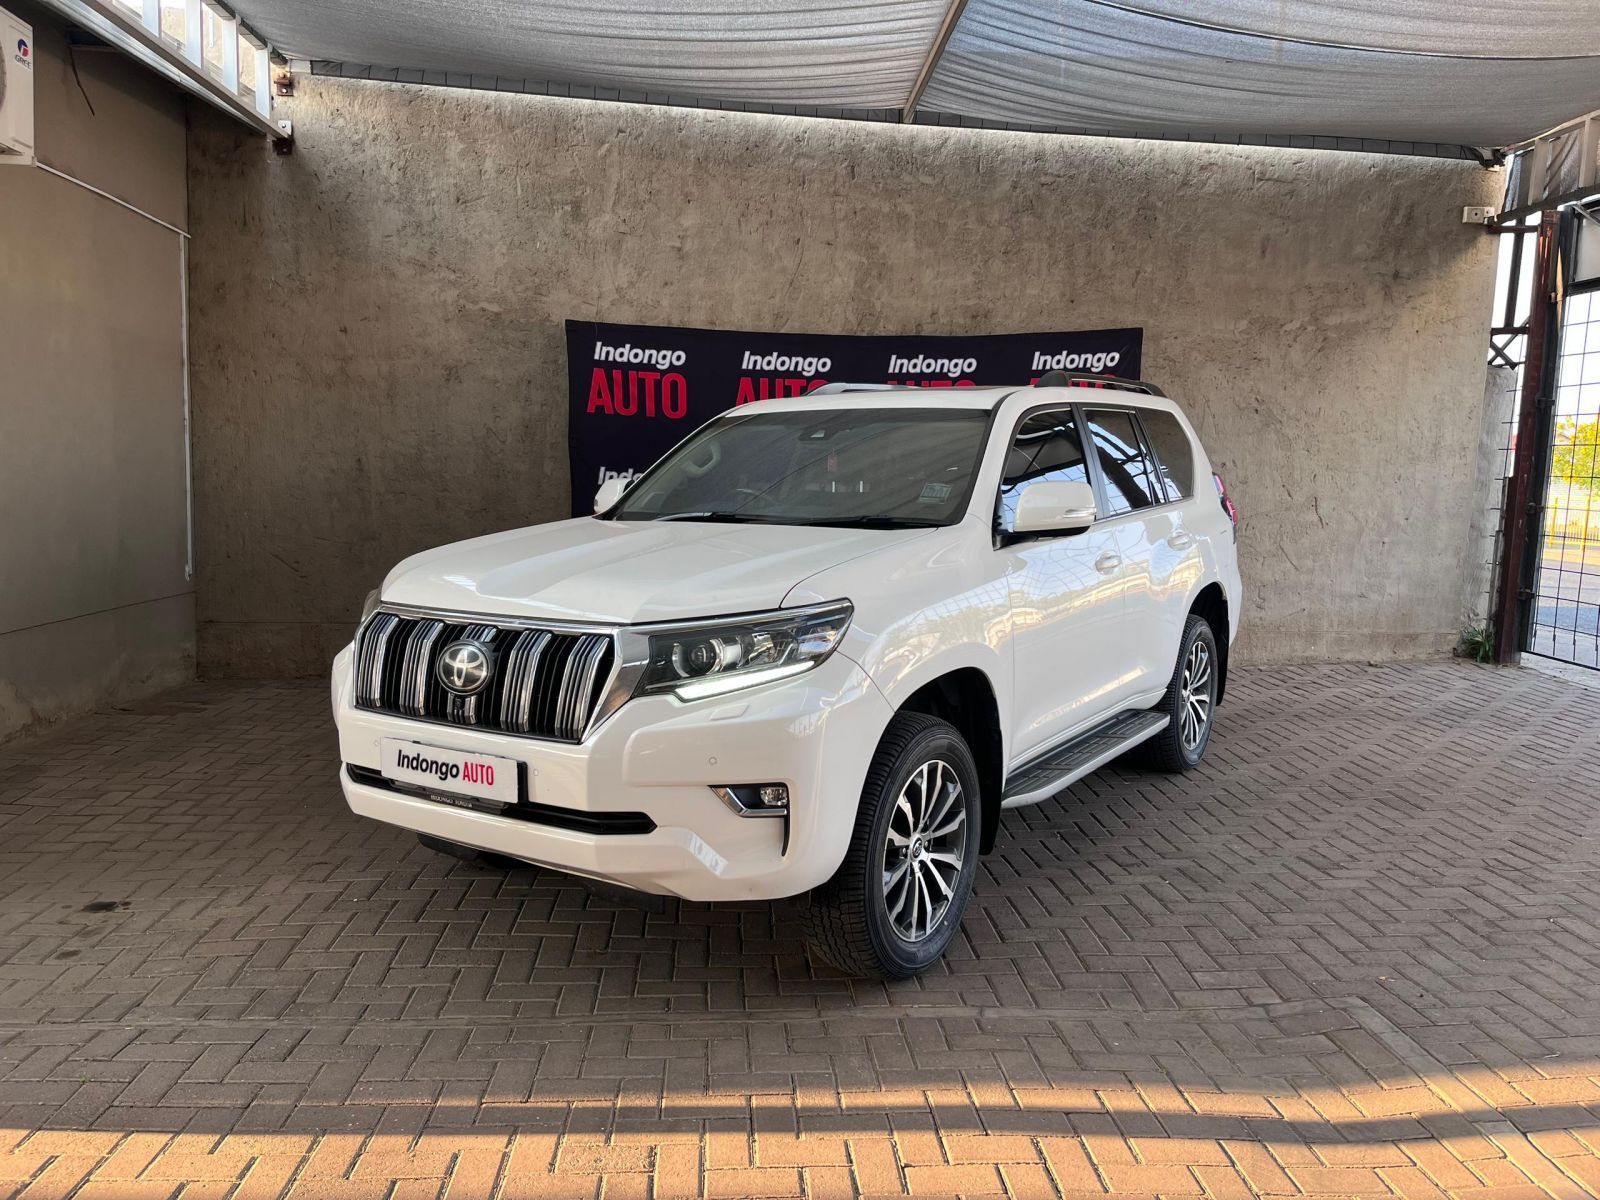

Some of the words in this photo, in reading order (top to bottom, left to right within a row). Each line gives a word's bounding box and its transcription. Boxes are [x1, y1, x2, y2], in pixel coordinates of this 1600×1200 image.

[15, 54, 32, 70] GREE
[593, 341, 686, 369] Indongo
[741, 350, 832, 377] Indongo
[888, 355, 977, 378] Indongo
[1031, 350, 1120, 373] Indongo
[586, 367, 688, 420] AUTO
[736, 376, 829, 406] AUT
[397, 749, 460, 781] Indongo
[462, 761, 495, 786] AUTO
